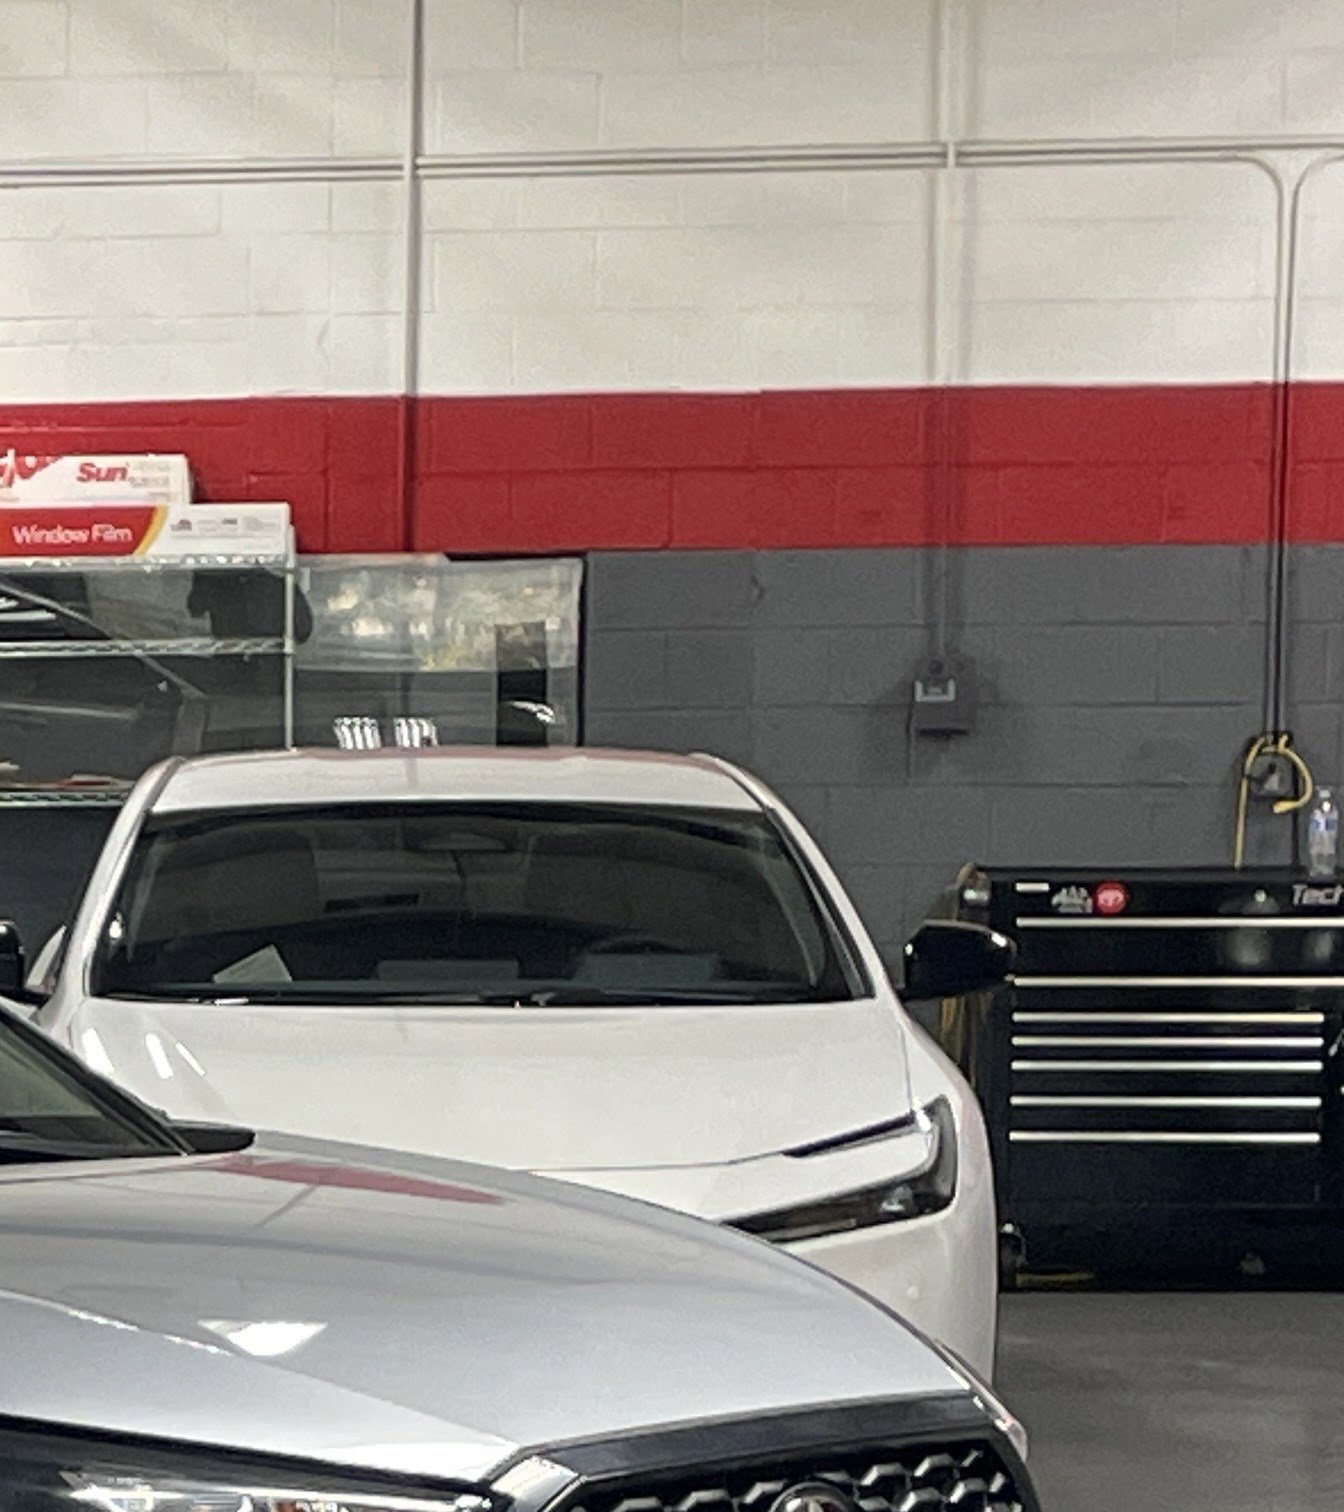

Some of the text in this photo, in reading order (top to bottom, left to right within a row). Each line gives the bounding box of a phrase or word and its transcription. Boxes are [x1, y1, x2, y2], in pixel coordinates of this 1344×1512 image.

[77, 462, 128, 482] Sun
[12, 523, 133, 544] Window Film
